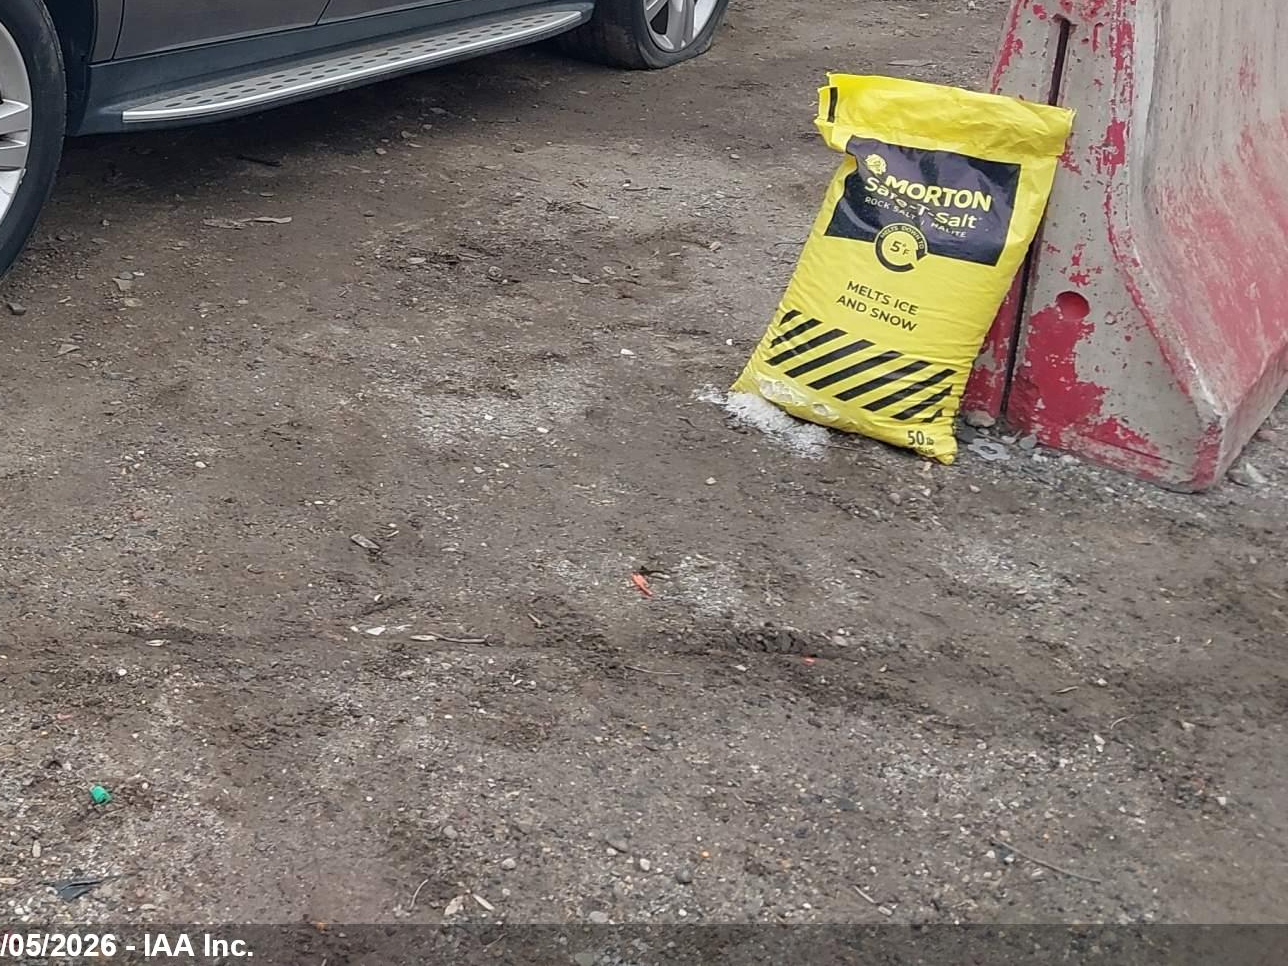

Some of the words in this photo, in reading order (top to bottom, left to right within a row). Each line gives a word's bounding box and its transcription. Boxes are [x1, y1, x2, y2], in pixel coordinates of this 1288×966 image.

[864, 196, 891, 210] ROCK
[884, 175, 993, 212] MORTON
[836, 295, 867, 313] AND
[869, 307, 918, 332] SNOW
[846, 280, 892, 305] MELTS
[893, 299, 919, 316] ICE
[907, 430, 925, 446] 50
